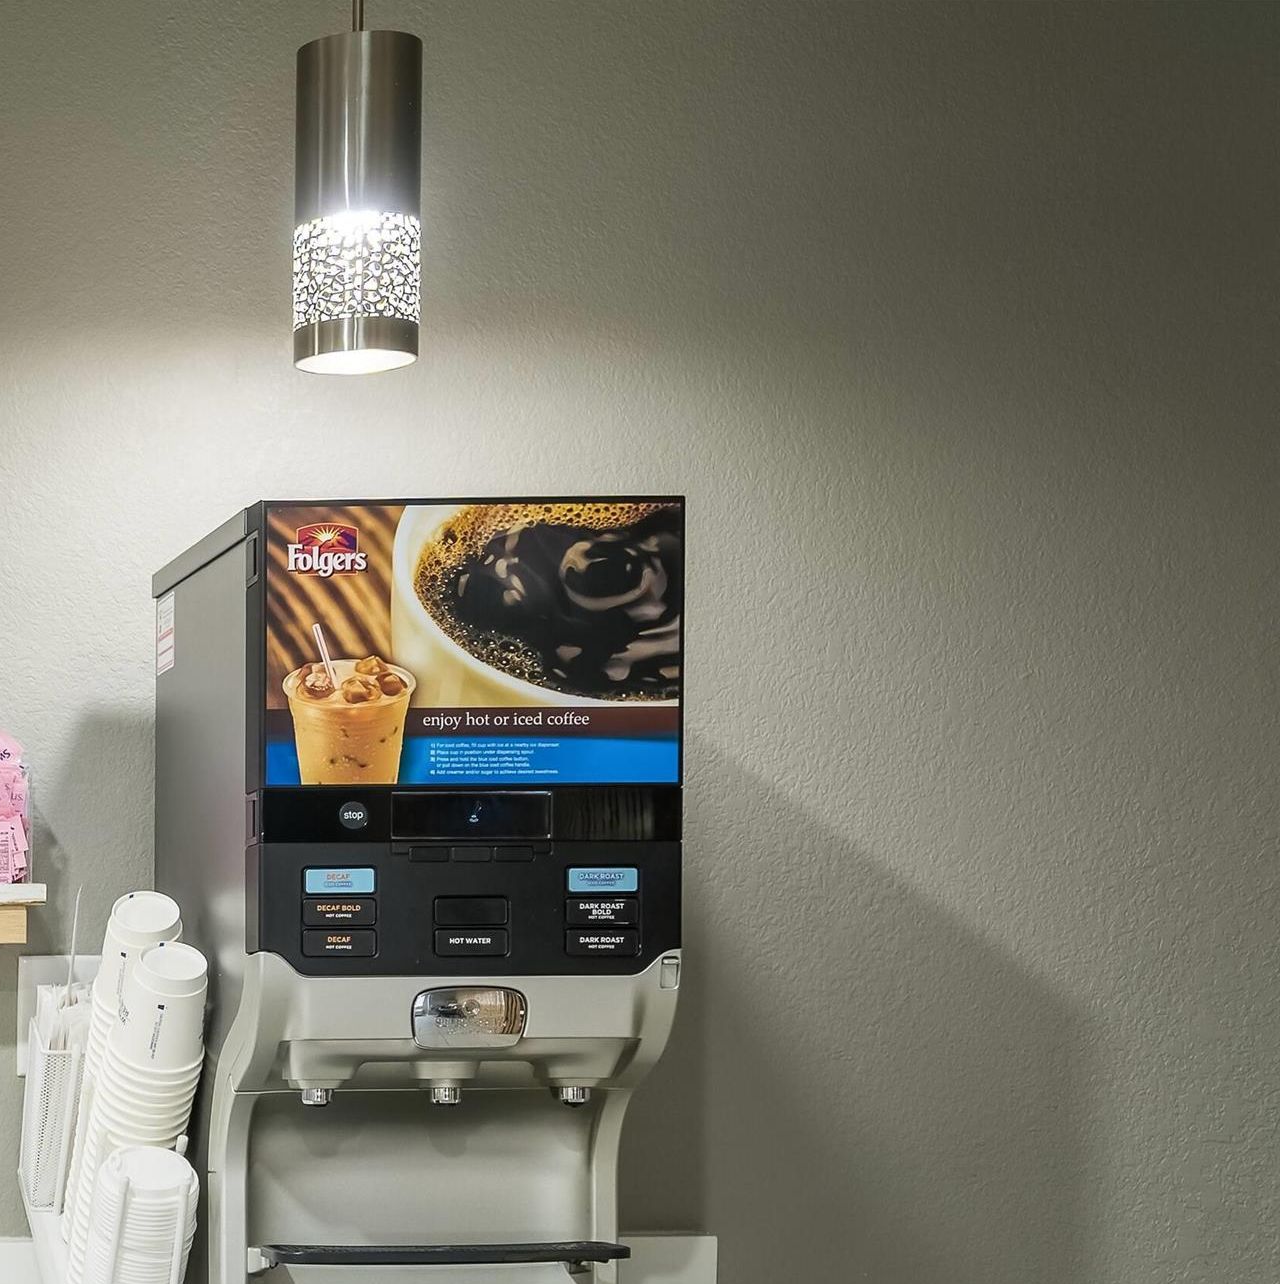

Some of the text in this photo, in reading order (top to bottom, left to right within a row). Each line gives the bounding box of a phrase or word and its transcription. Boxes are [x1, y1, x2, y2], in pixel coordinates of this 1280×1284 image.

[286, 543, 368, 577] Folgers
[422, 711, 590, 730] enjoy hot or iced coffee
[343, 811, 364, 821] stop
